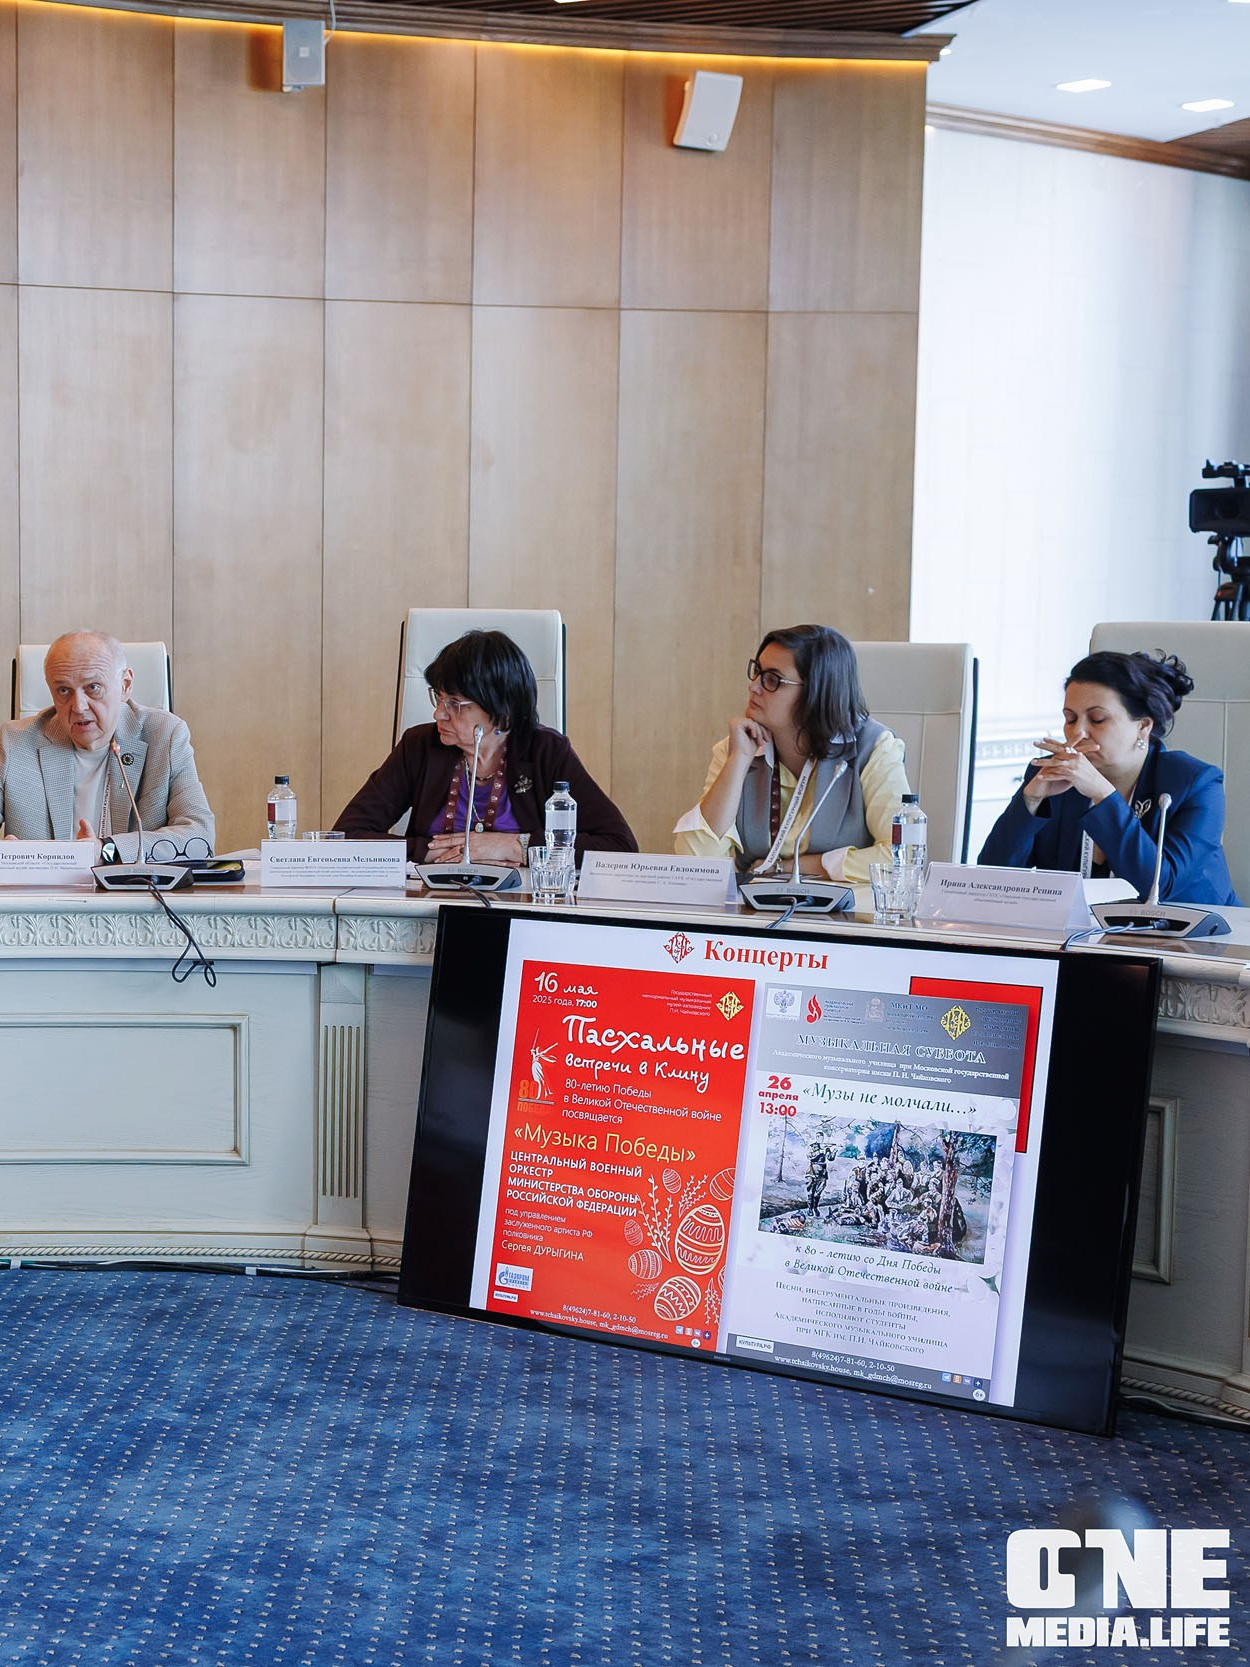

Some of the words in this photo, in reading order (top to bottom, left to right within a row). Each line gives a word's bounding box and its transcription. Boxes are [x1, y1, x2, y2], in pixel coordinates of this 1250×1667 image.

[595, 861, 629, 870] Валерия
[630, 863, 668, 872] Юрьевна
[670, 864, 720, 874] Евдокимова
[940, 879, 967, 889] Ирина
[968, 881, 1030, 894] Александровна
[1032, 887, 1063, 896] Репина
[704, 939, 828, 972] Концерты
[534, 971, 558, 993] 16
[562, 985, 598, 995] мая
[532, 993, 552, 1004] 2025
[553, 998, 573, 1007] года,
[575, 998, 598, 1008] 17:00
[562, 1013, 744, 1061] Пасхальные
[795, 1031, 912, 1058] МУЗЫКАЛЬНАЯ
[914, 1045, 989, 1065] СУББОТА
[564, 1054, 631, 1078] встречи
[638, 1061, 648, 1075] в
[653, 1060, 709, 1094] Клину
[766, 1075, 791, 1090] 26
[564, 1078, 611, 1094] 80-летию
[611, 1083, 652, 1098] Победы
[758, 1090, 798, 1101] апреля
[561, 1109, 622, 1124] посвящается
[563, 1094, 570, 1103] в
[570, 1093, 612, 1107] Великой
[613, 1098, 689, 1117] Отечественной
[690, 1109, 722, 1122] войне
[760, 1101, 797, 1117] 13:00
[513, 1122, 598, 1150] «Музыка
[604, 1131, 696, 1163] Победы»
[509, 1163, 553, 1177] ОРКЕСТР
[510, 1150, 587, 1169] ЦЕНТРАЛЬНЫЙ
[589, 1161, 642, 1177] ВОЕННЫЙ
[507, 1175, 584, 1196] МИНИСТЕРСТВА
[586, 1187, 637, 1204] ОБОРОНЫ
[505, 1188, 574, 1207] РОССИЙСКОЙ
[575, 1199, 638, 1217] ФЕДЕРАЦИИ
[505, 1208, 518, 1216] под
[519, 1210, 566, 1222] управлением
[501, 1229, 543, 1242] полковника
[503, 1218, 552, 1232] заслуженного
[553, 1225, 580, 1237] артиста
[581, 1229, 593, 1238] РФ
[500, 1238, 532, 1253] Сергея
[532, 1243, 584, 1261] ДУРЫГИНА
[804, 1245, 816, 1255] 80
[826, 1251, 861, 1262] летию
[863, 1256, 874, 1264] со
[876, 1255, 898, 1267] Дня
[901, 1259, 941, 1275] Победы
[793, 1259, 834, 1274] Великой
[837, 1265, 919, 1287] Отечественной
[922, 1282, 953, 1293] войне
[562, 1304, 611, 1320] 8(49624)7-81-60,
[612, 1313, 636, 1323] 2-10-50
[738, 1339, 772, 1349] КУЛЬТУРА.РФ
[811, 1350, 867, 1368] 8(49624)7-81-60,
[868, 1361, 895, 1372] 2-10-50
